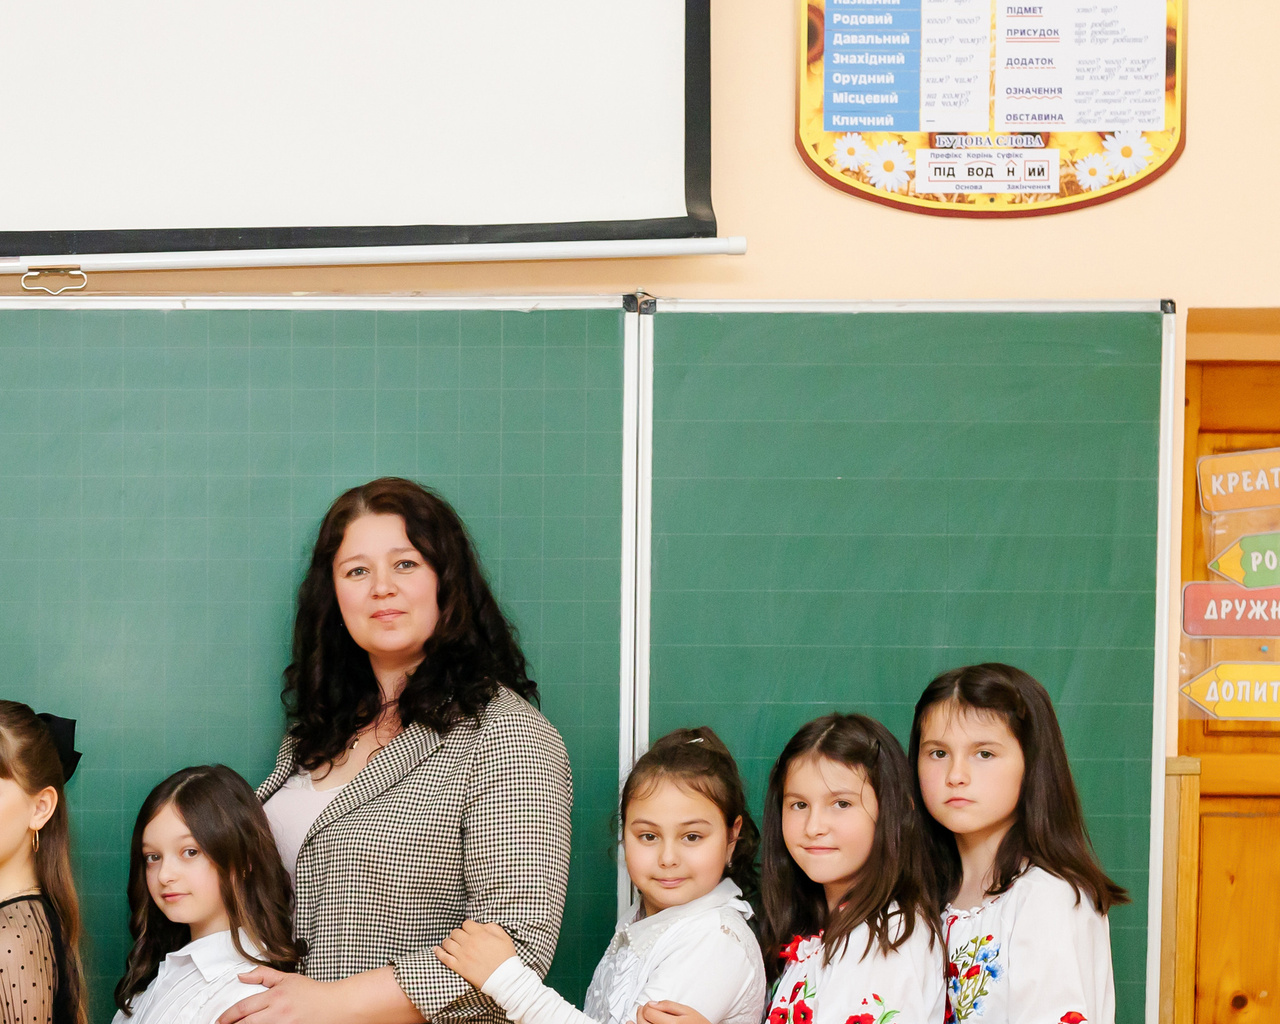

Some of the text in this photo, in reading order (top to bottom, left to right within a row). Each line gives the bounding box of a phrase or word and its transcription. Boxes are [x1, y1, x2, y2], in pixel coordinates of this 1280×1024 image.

[1006, 6, 1044, 15] ПІДМЕТ
[833, 13, 893, 25] Родовий
[832, 33, 910, 45] Давальний
[1006, 29, 1060, 37] ПРИСУДОК
[832, 53, 905, 65] Знахідний
[1006, 58, 1054, 66] ДОДАТОК
[832, 72, 895, 85] Орудний
[1005, 87, 1063, 95] ОЗНАЧЕННЯ
[832, 92, 899, 105] Місцевий
[832, 114, 894, 126] Кличний
[1005, 113, 1064, 122] ОБСТАВИНА
[936, 135, 1045, 149] БУДОВА СЛОВА
[933, 164, 1045, 178] ПІД ВОД Н ИЙ
